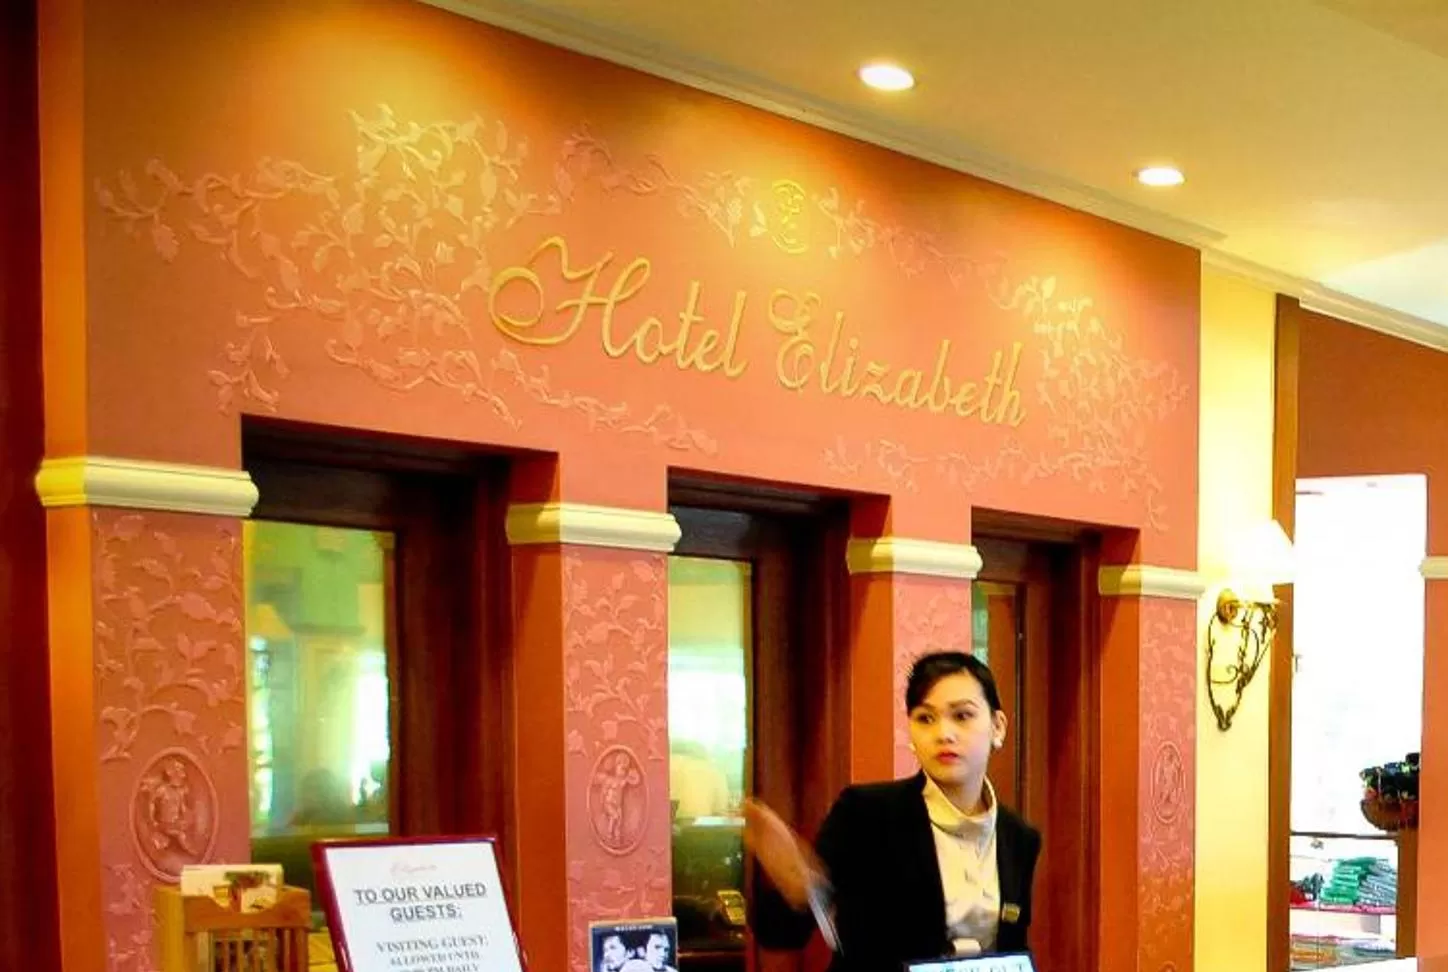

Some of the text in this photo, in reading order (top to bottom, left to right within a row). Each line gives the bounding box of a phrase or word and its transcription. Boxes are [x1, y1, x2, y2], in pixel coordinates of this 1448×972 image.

[487, 236, 1027, 428] Hotel Elizabeth
[354, 882, 486, 903] TO OUR VALUED
[376, 938, 439, 952] VISITING
